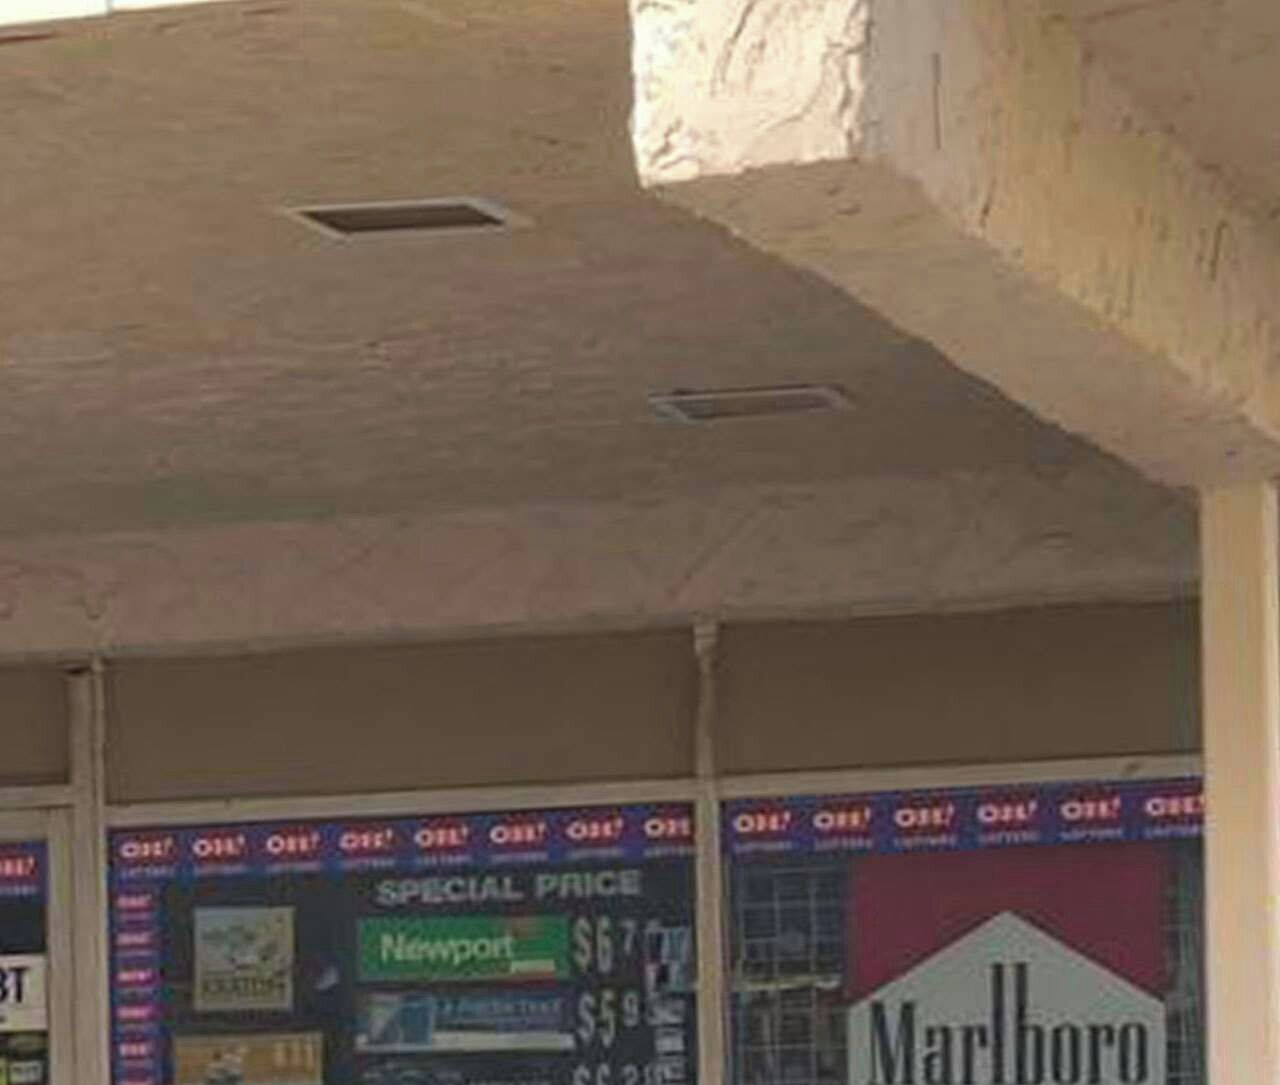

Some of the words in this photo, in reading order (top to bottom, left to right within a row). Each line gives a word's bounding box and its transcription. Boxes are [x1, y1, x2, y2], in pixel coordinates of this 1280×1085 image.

[376, 874, 526, 904] SPECIAL
[535, 869, 640, 900] PRICE
[380, 931, 517, 964] Newport
